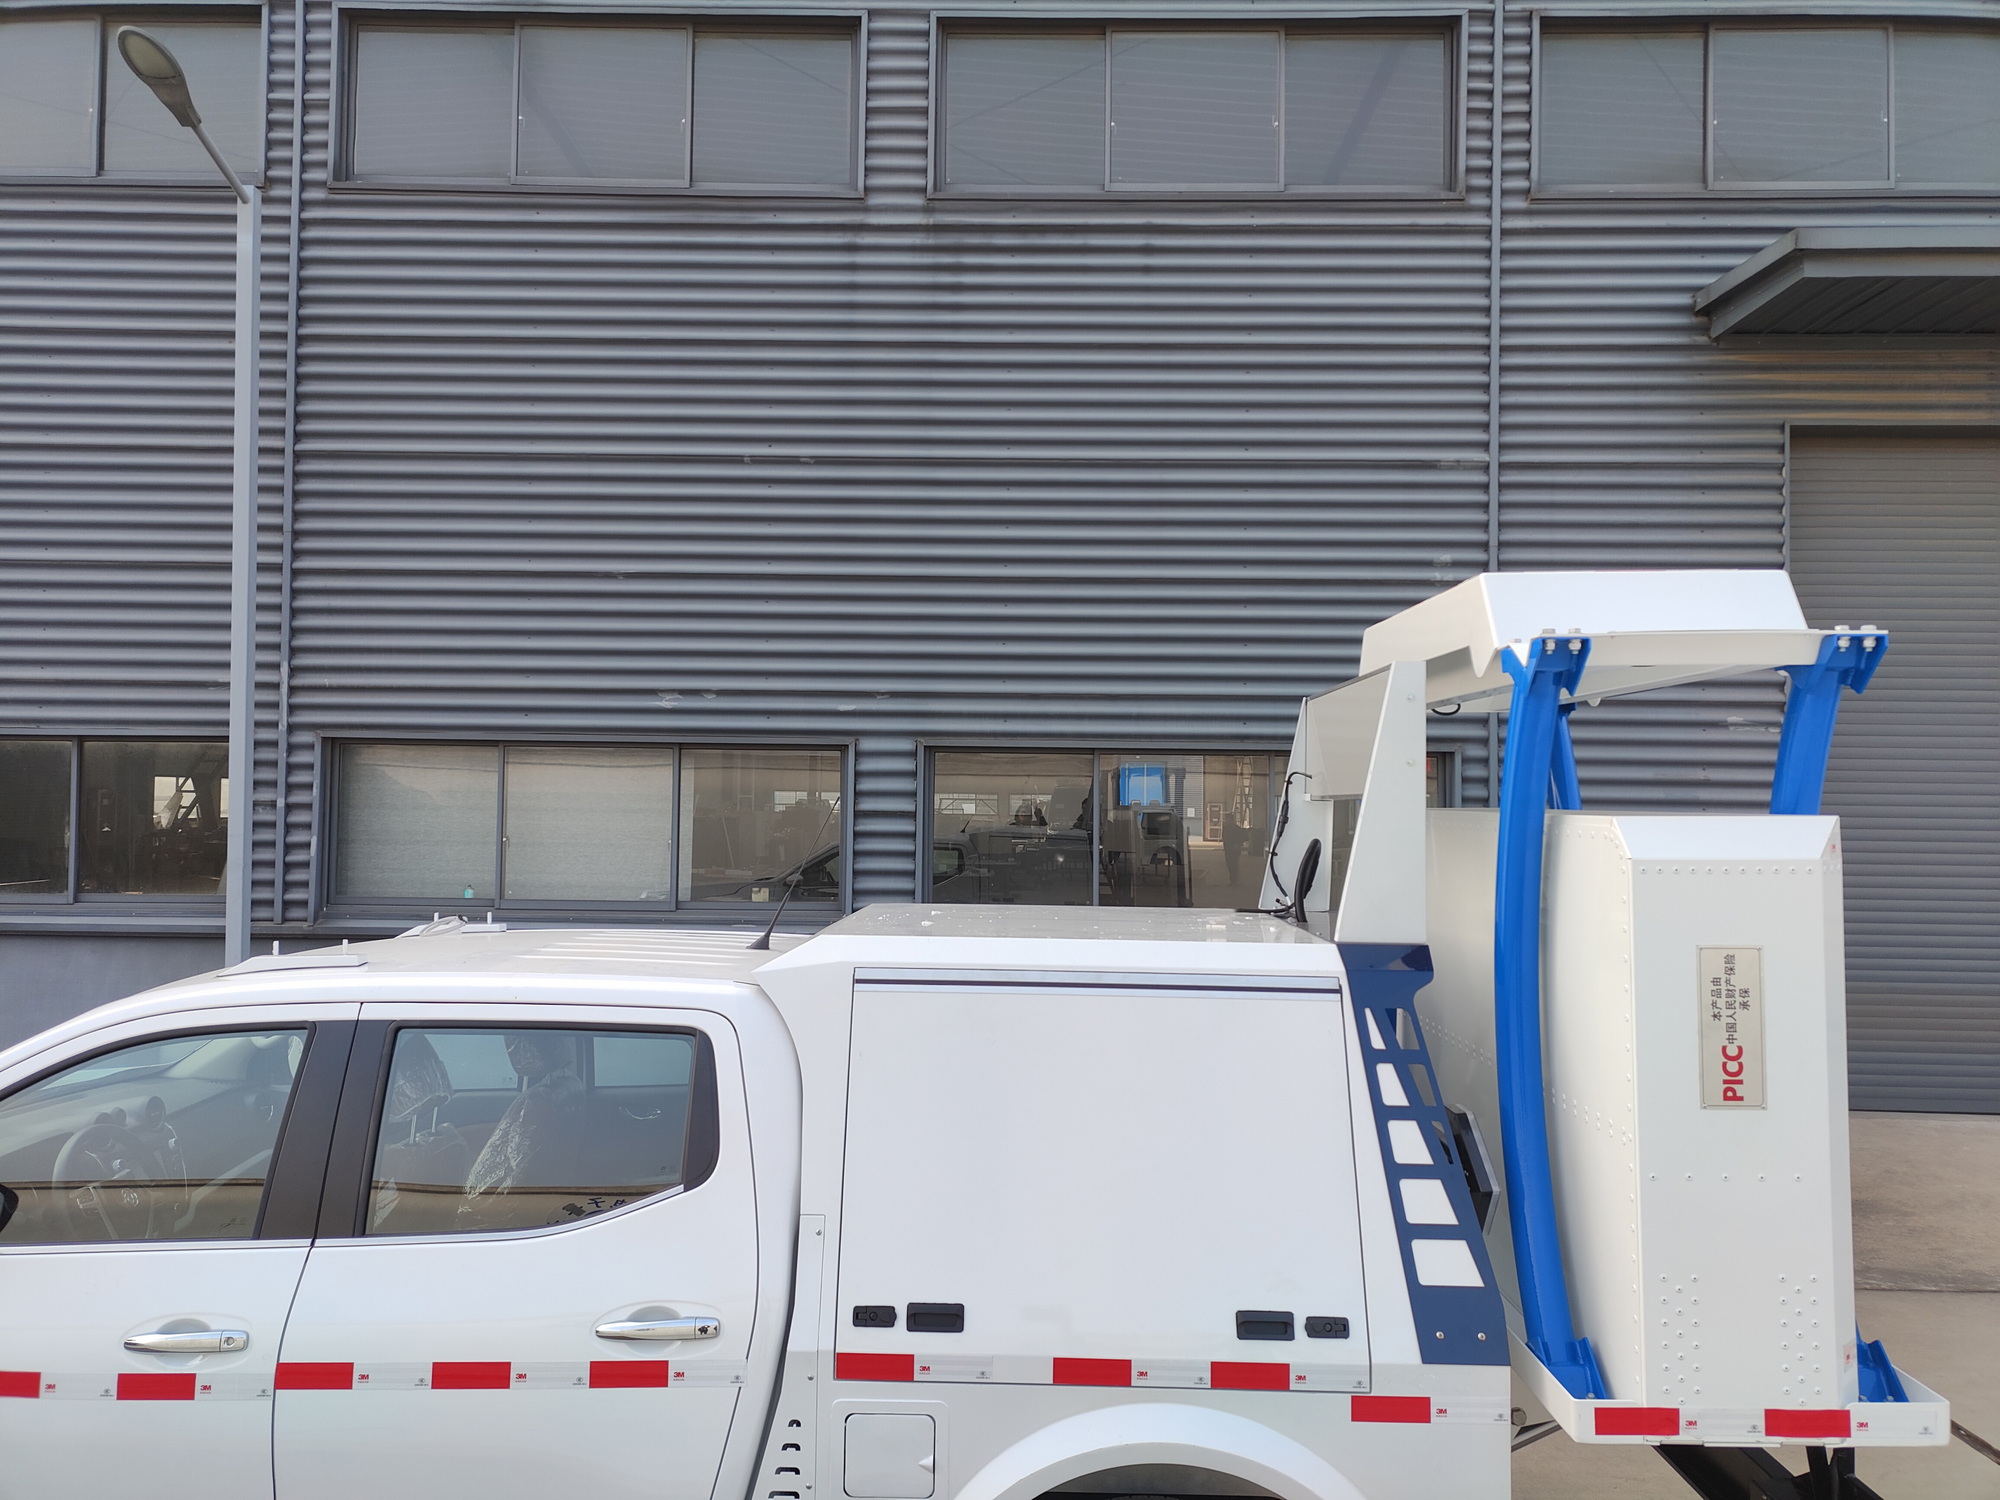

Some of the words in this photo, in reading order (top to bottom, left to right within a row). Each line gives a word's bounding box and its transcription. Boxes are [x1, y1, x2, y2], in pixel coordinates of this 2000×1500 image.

[1710, 976, 1723, 1021] 本产品由
[1724, 953, 1737, 1044] 中国人民财产保险
[1739, 987, 1751, 1011] 承保
[1721, 1045, 1744, 1101] PICC
